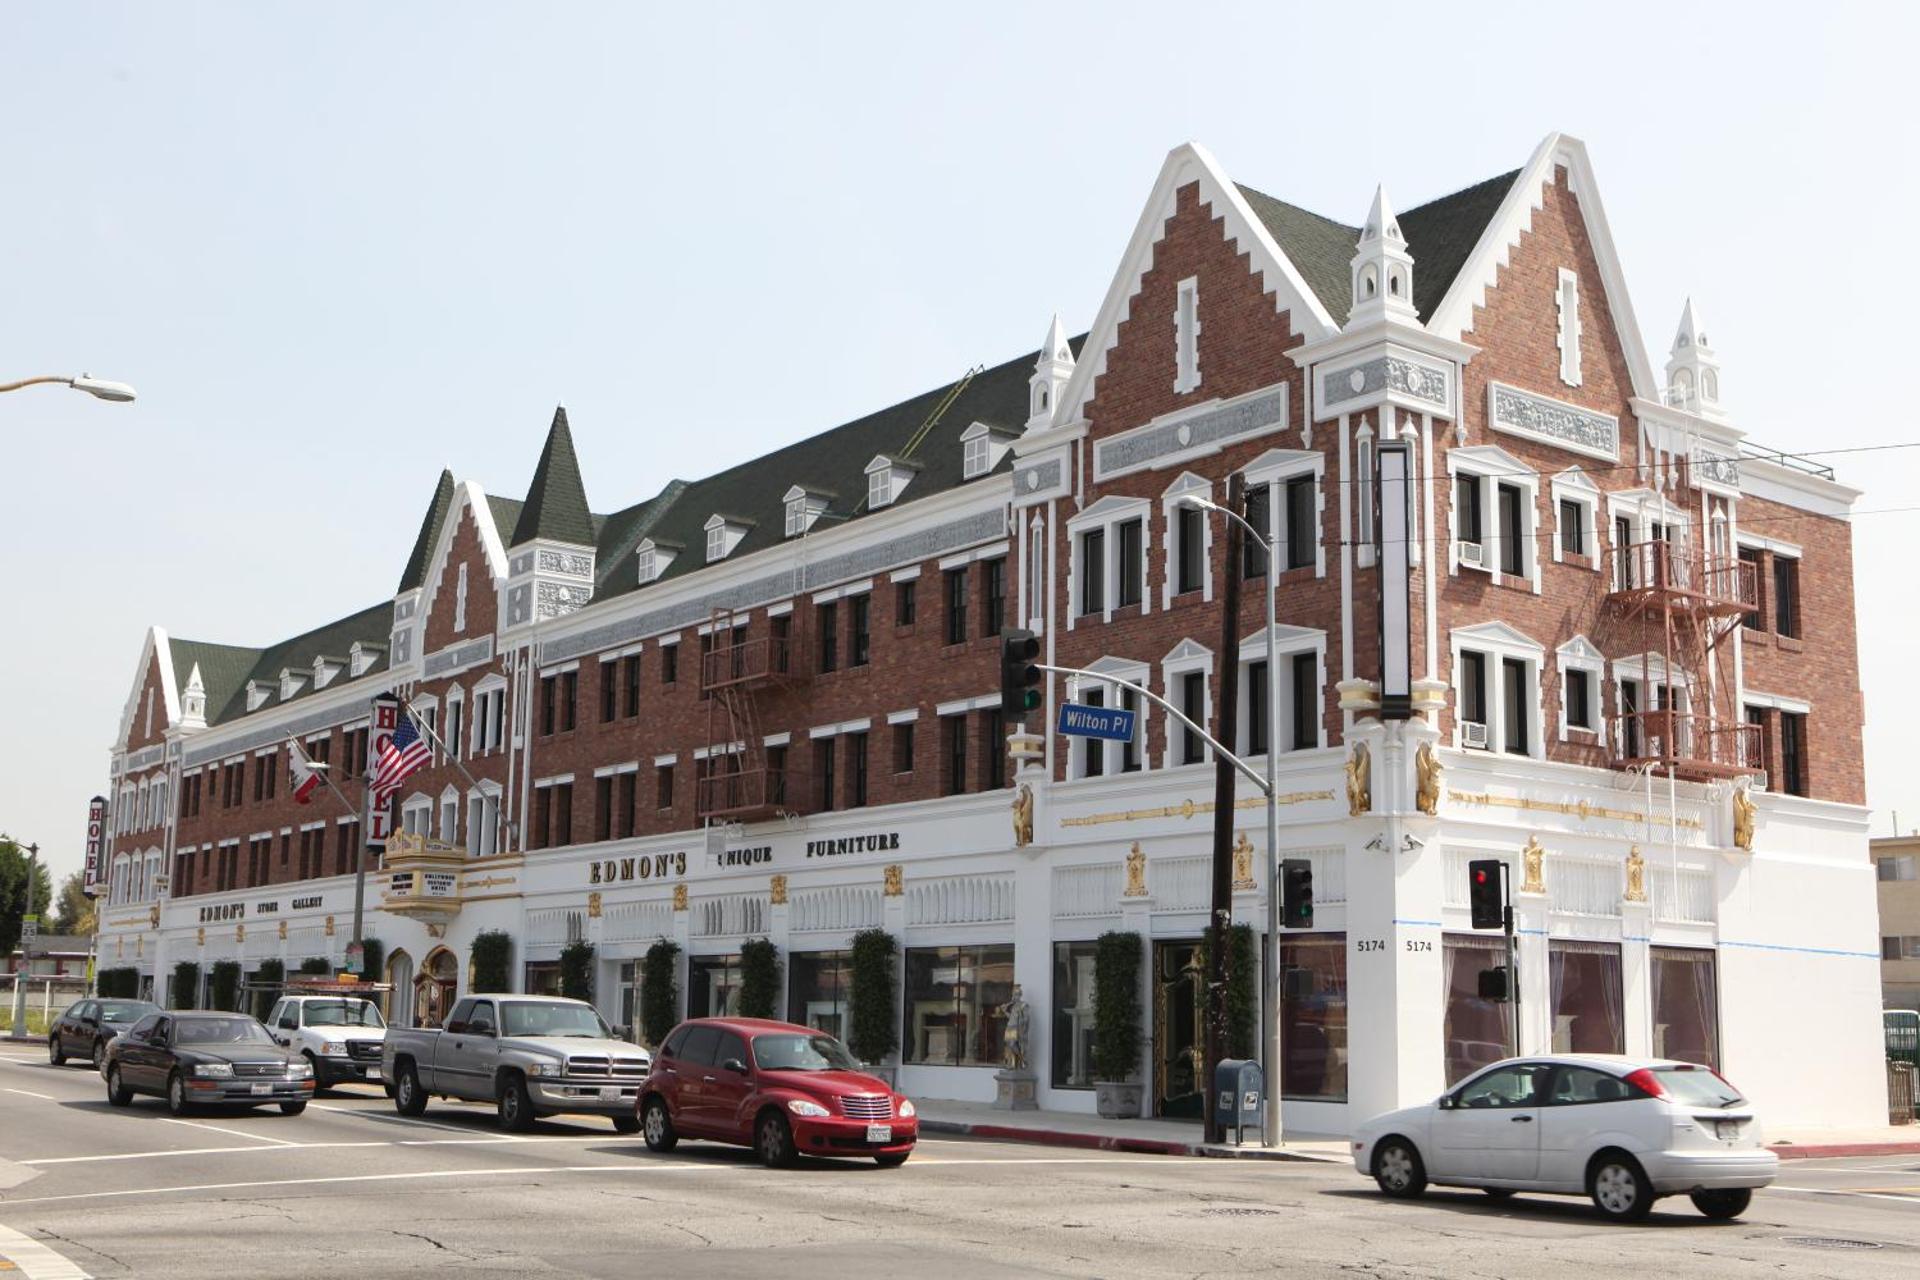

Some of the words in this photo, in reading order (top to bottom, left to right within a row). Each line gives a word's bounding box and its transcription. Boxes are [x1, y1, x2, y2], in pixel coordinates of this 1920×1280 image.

[1067, 711, 1107, 731] Wilton
[1113, 716, 1128, 733] Pl
[86, 808, 102, 886] HOTEL
[589, 852, 687, 884] EDMON'S
[806, 833, 899, 858] FURNITURE
[200, 903, 245, 922] EDMON'S
[292, 896, 323, 910] GALLERY
[23, 928, 36, 937] 25
[1357, 940, 1385, 952] 5174
[1406, 940, 1432, 952] 5174
